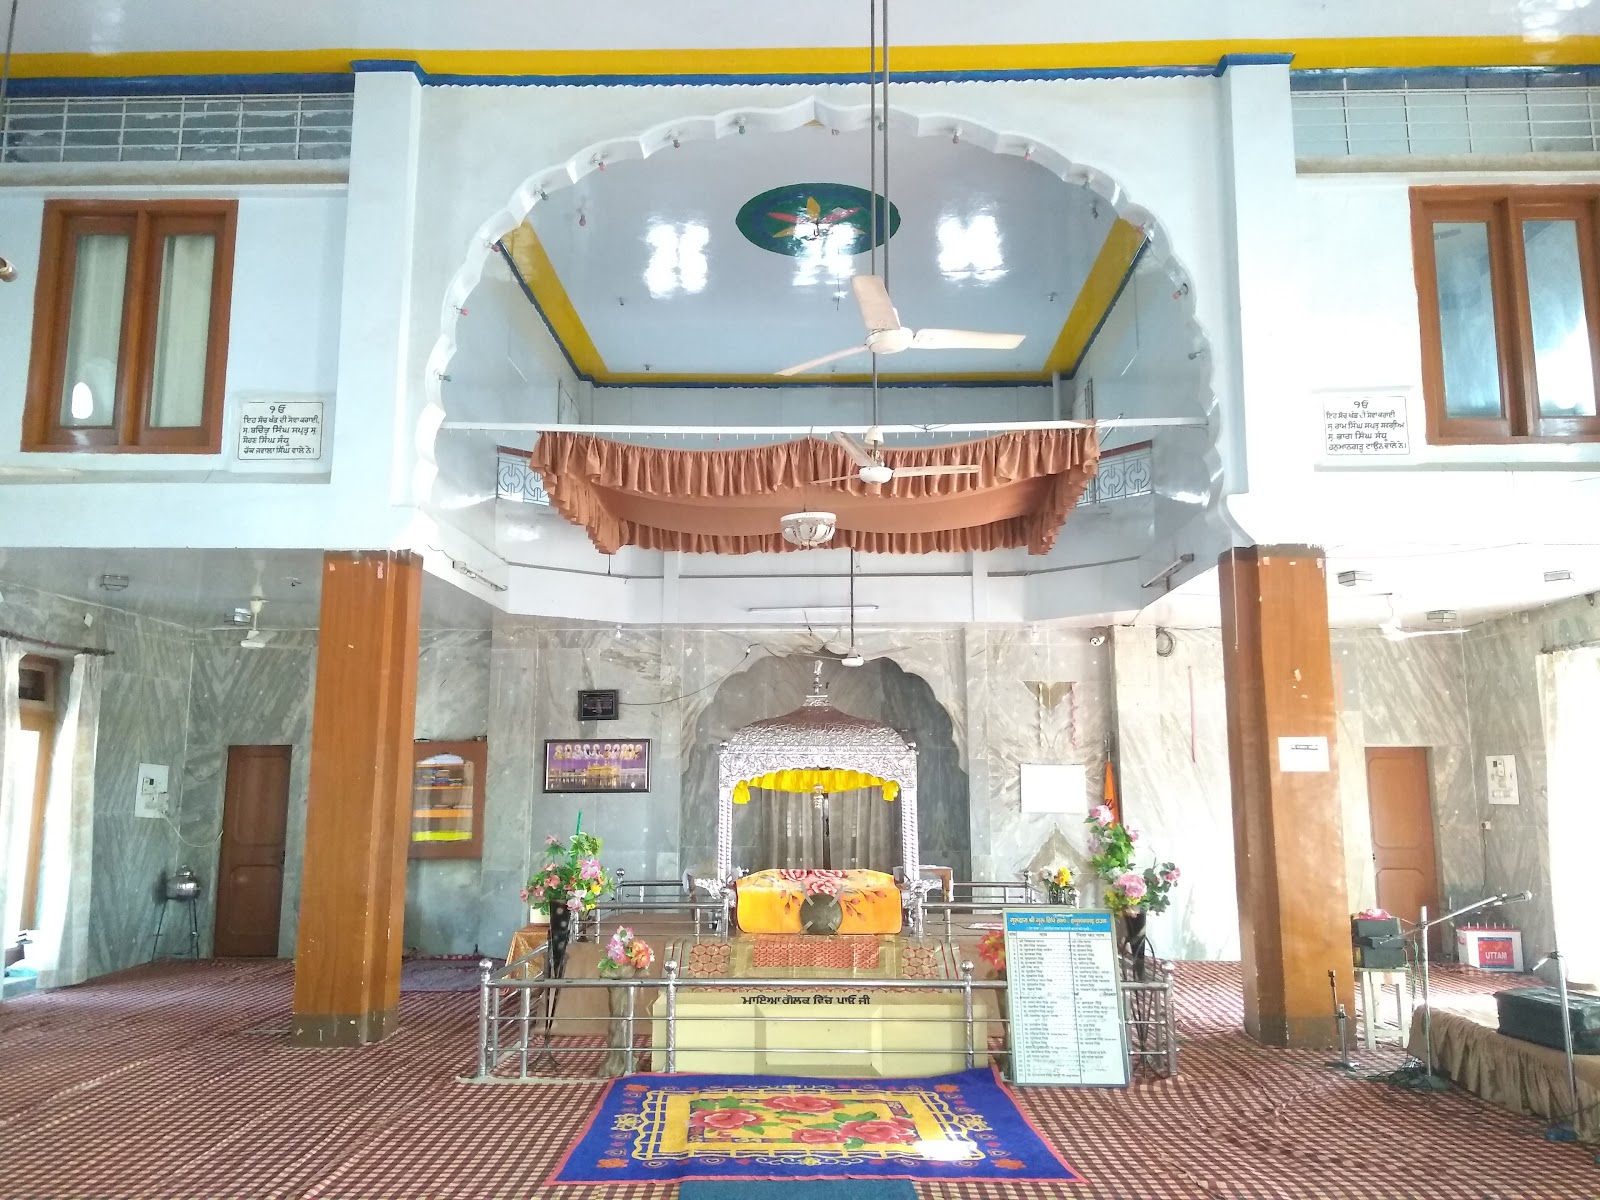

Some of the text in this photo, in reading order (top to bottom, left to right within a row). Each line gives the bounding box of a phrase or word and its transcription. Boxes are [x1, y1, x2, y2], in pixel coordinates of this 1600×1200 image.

[272, 424, 290, 434] ਸਿੰਘ
[1347, 420, 1363, 429] ਸਿੰਘ
[258, 435, 276, 444] ਸਿੰਘ
[1354, 430, 1373, 440] ਸਿੰਘ
[1485, 951, 1508, 960] UTTAM
[741, 994, 782, 1005] ਮਾਇਆ
[858, 994, 871, 1005] ਜੀ
